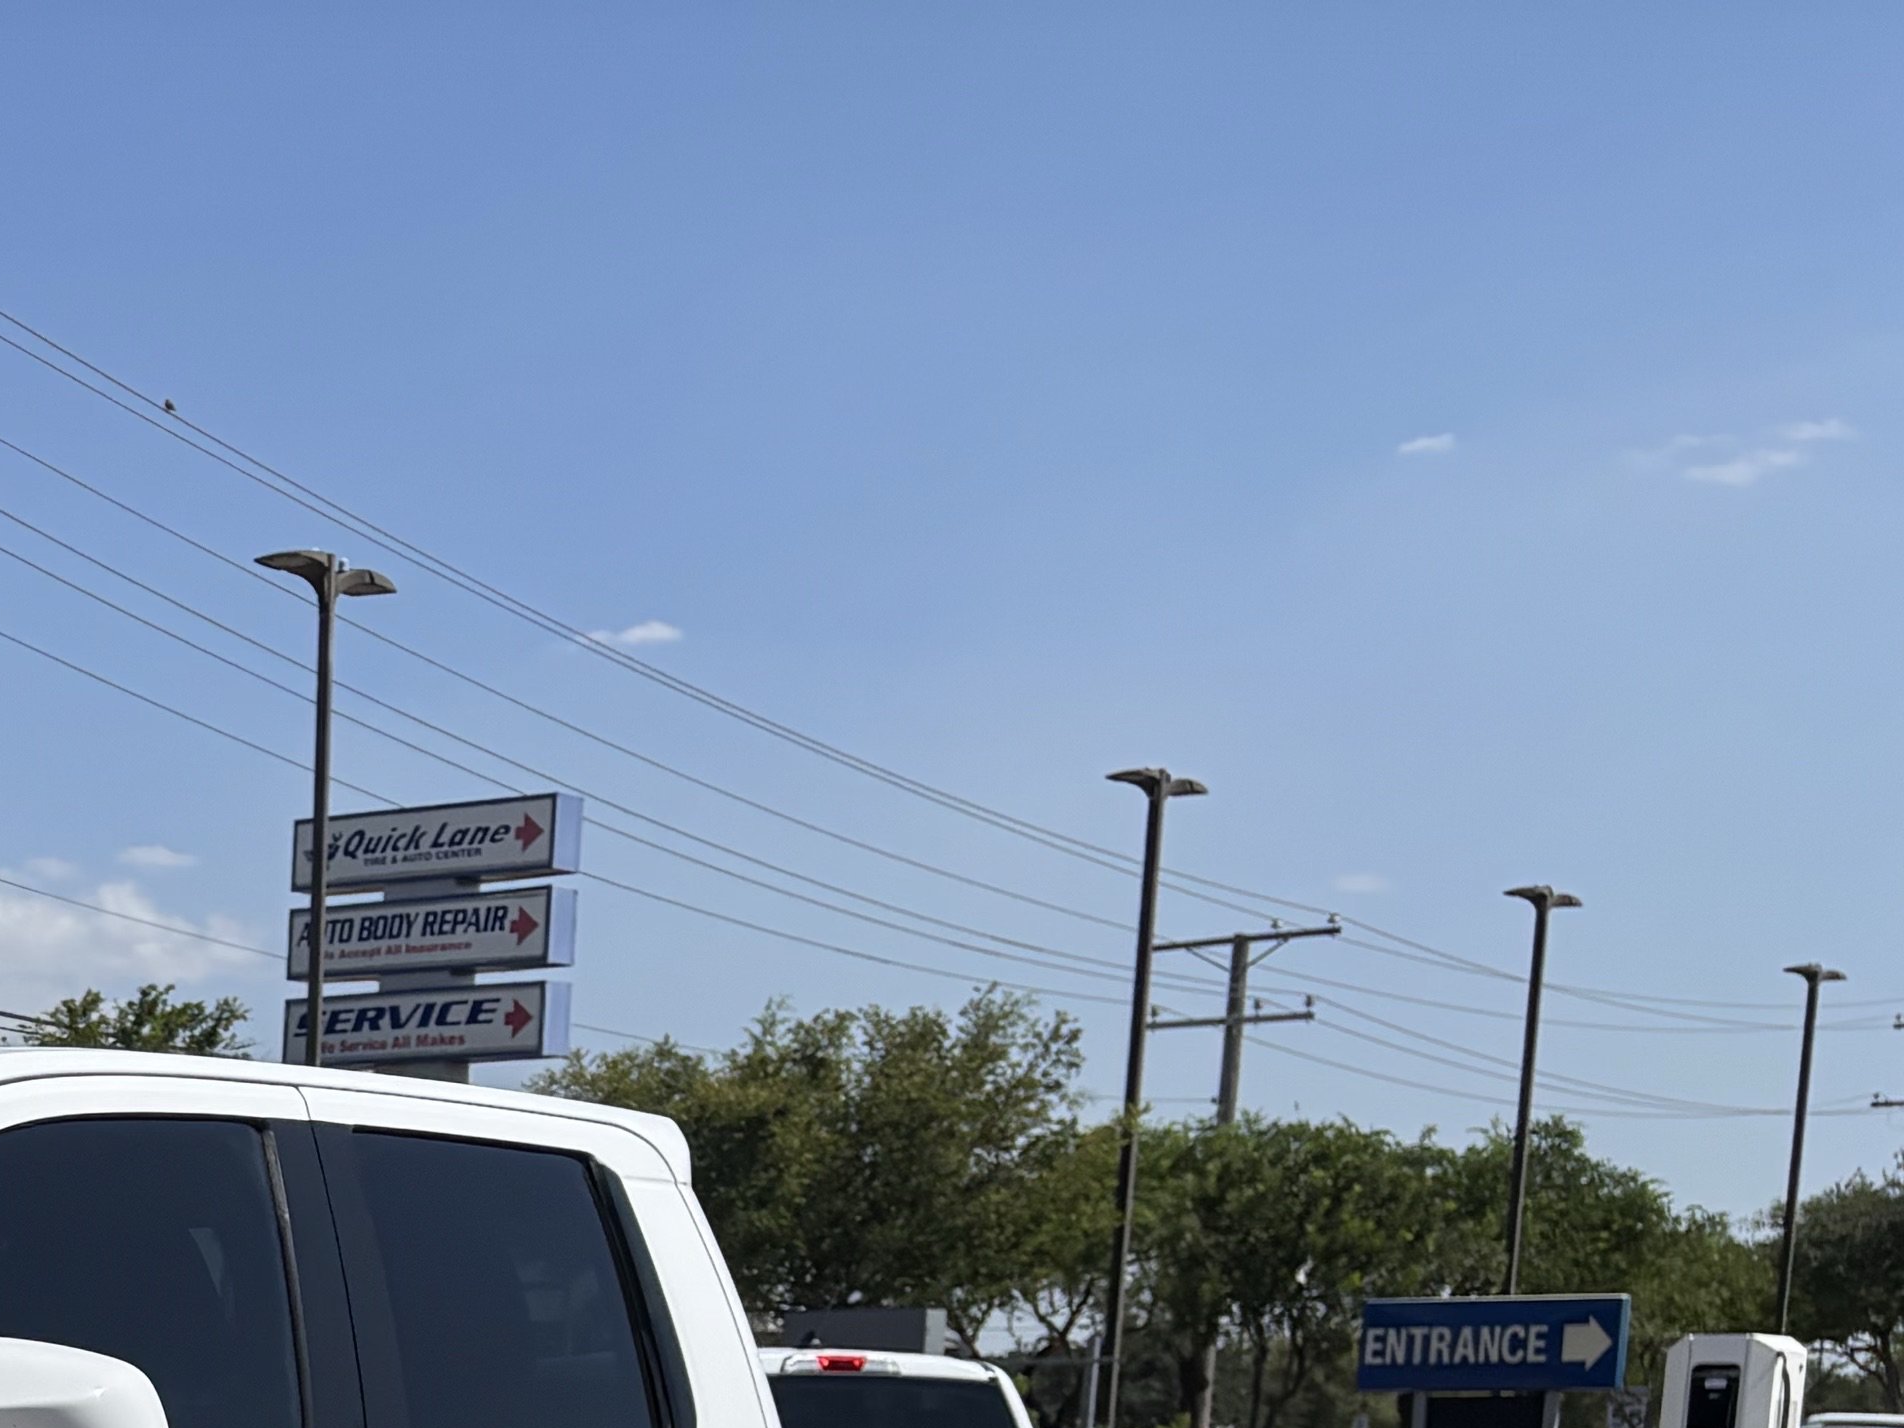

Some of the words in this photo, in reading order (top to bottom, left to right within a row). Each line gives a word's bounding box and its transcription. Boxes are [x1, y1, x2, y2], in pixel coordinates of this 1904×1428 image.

[343, 825, 427, 859] Quick
[430, 822, 511, 850] Lane
[401, 851, 433, 863] AUTO
[436, 847, 483, 860] CENTER
[297, 917, 354, 947] ATO
[358, 912, 420, 945] BODY
[421, 905, 508, 937] REPAIR
[340, 1038, 387, 1052] Service
[392, 1034, 411, 1049] All
[416, 1033, 465, 1048] Makes
[1364, 1324, 1549, 1366] ENTRANCE
